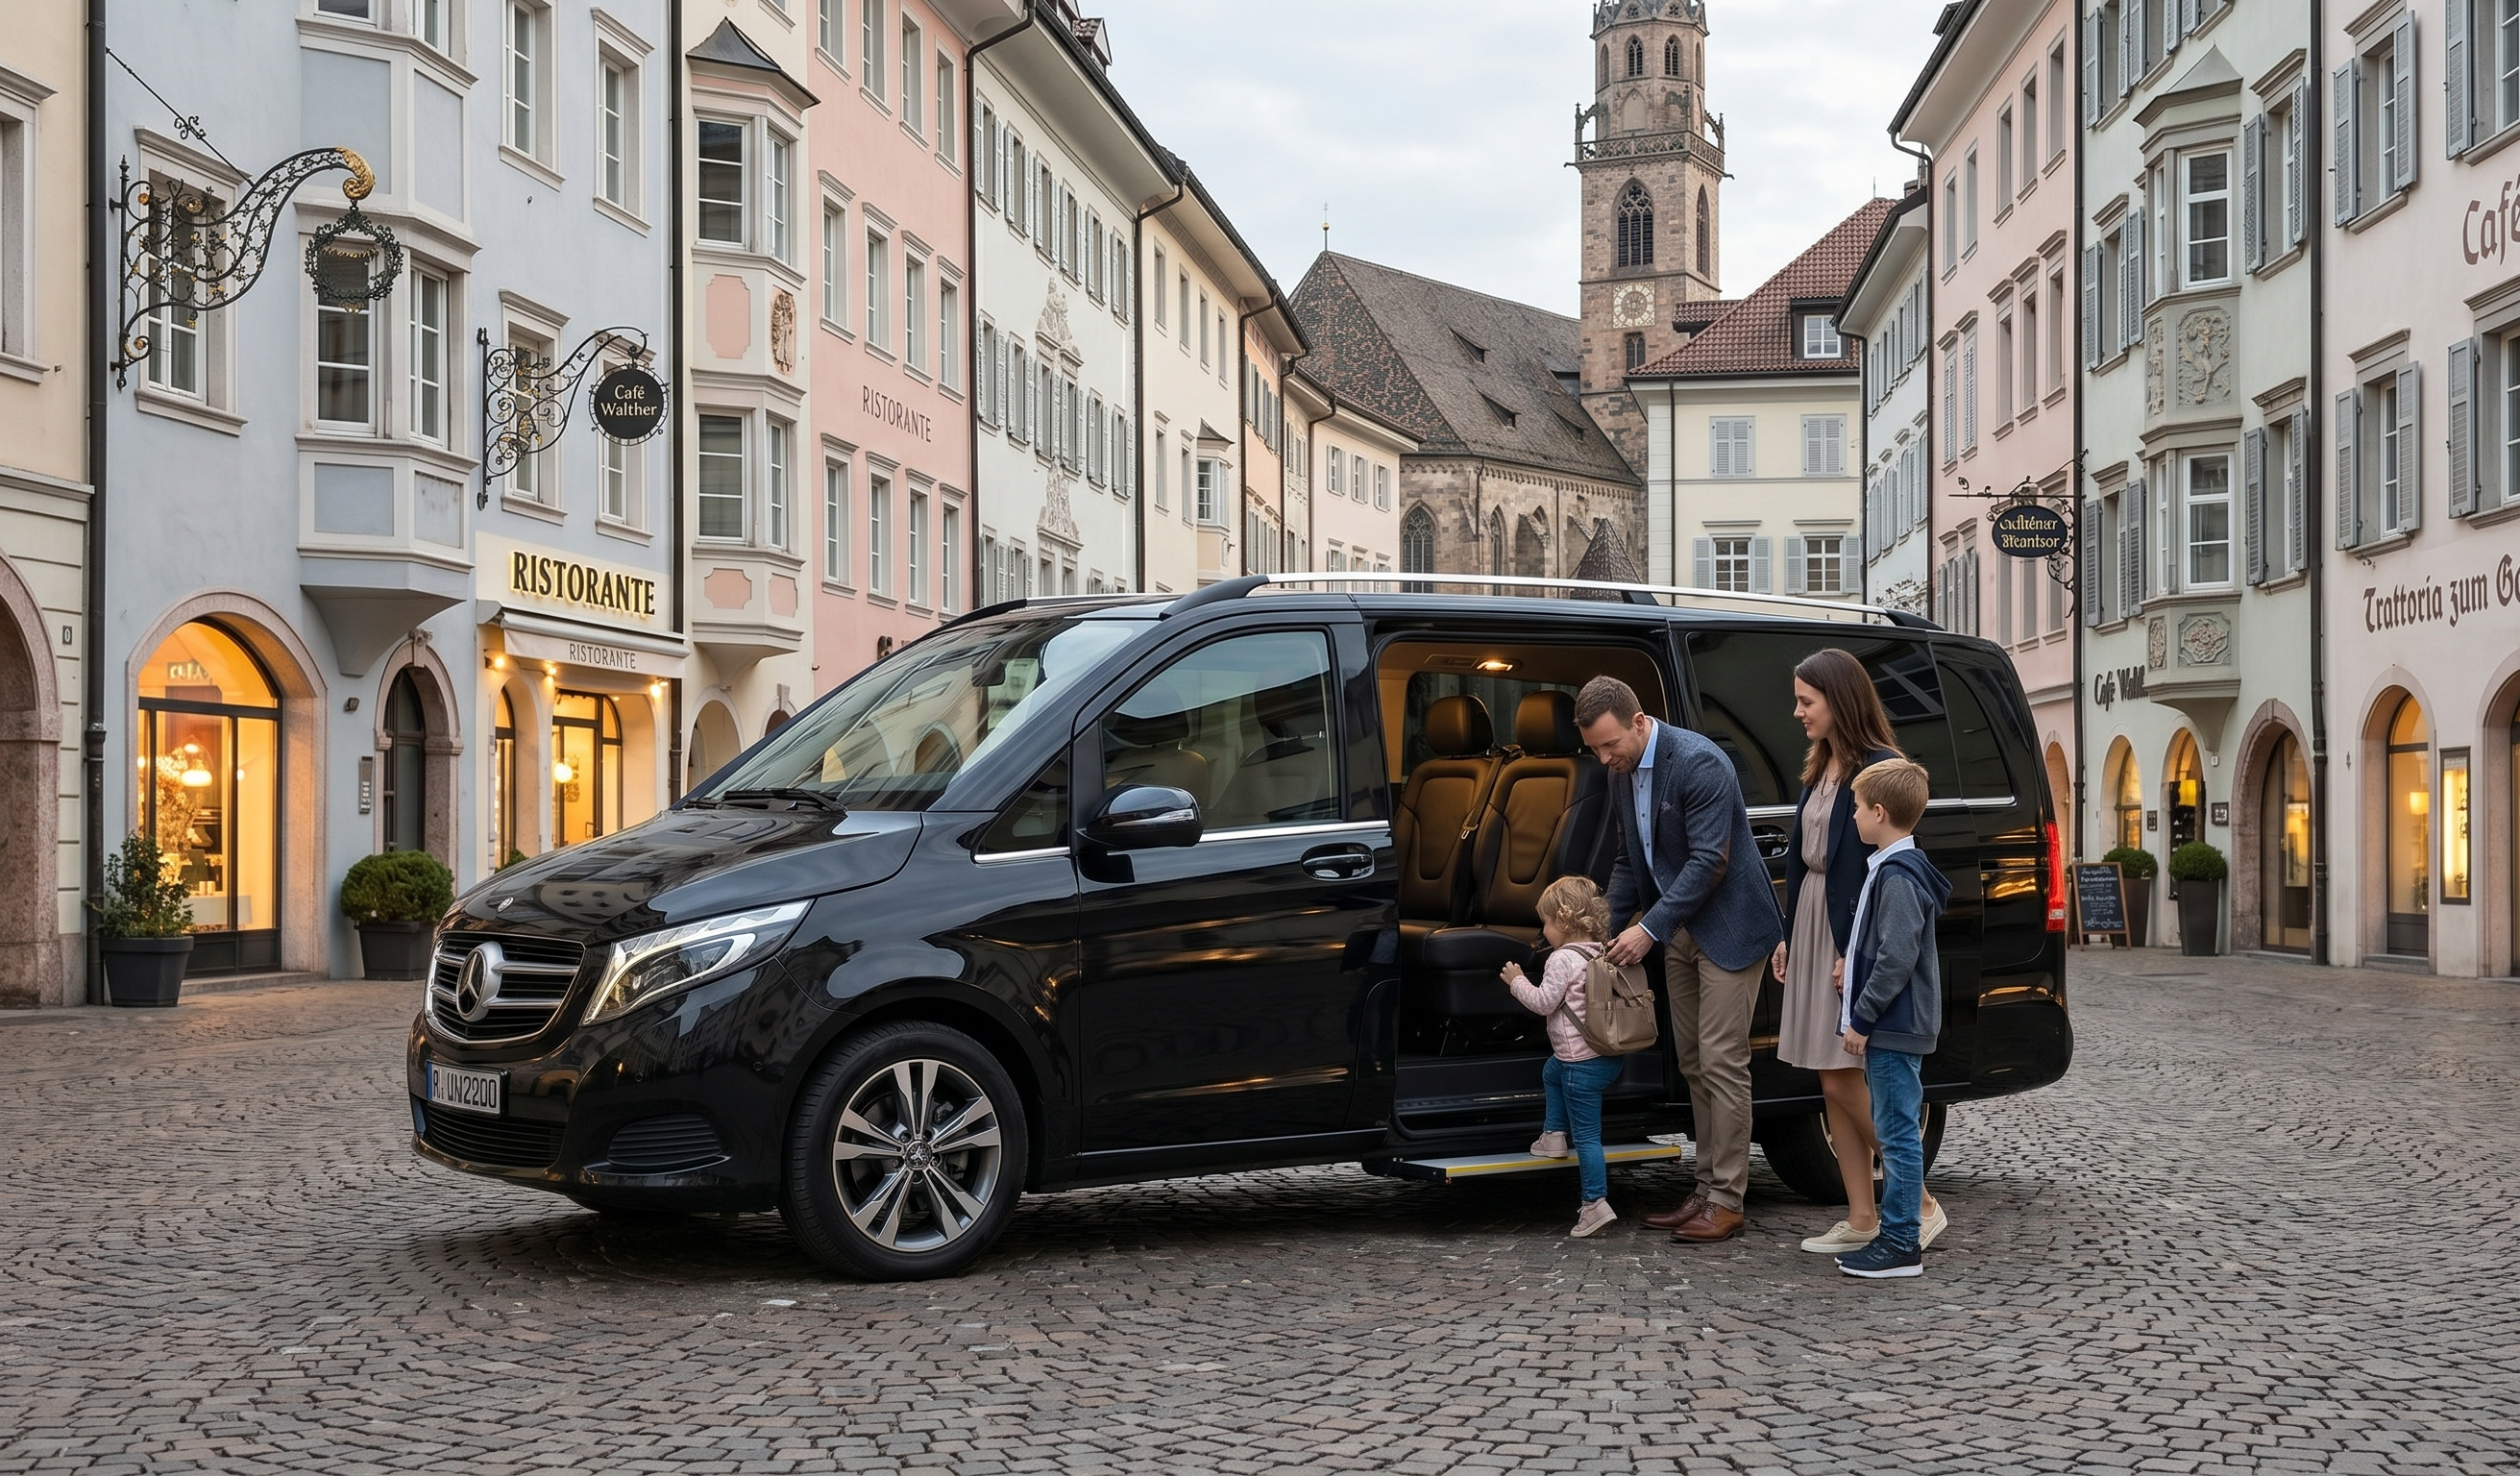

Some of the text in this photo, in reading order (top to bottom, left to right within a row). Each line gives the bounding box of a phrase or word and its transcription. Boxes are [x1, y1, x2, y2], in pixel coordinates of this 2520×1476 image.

[600, 402, 658, 416] Walther
[863, 384, 932, 443] RISTORANTE
[512, 551, 655, 616] RISTORANTE
[2362, 575, 2443, 634] Trattoria
[2449, 573, 2489, 628] zum
[569, 643, 636, 670] RISTORANTE
